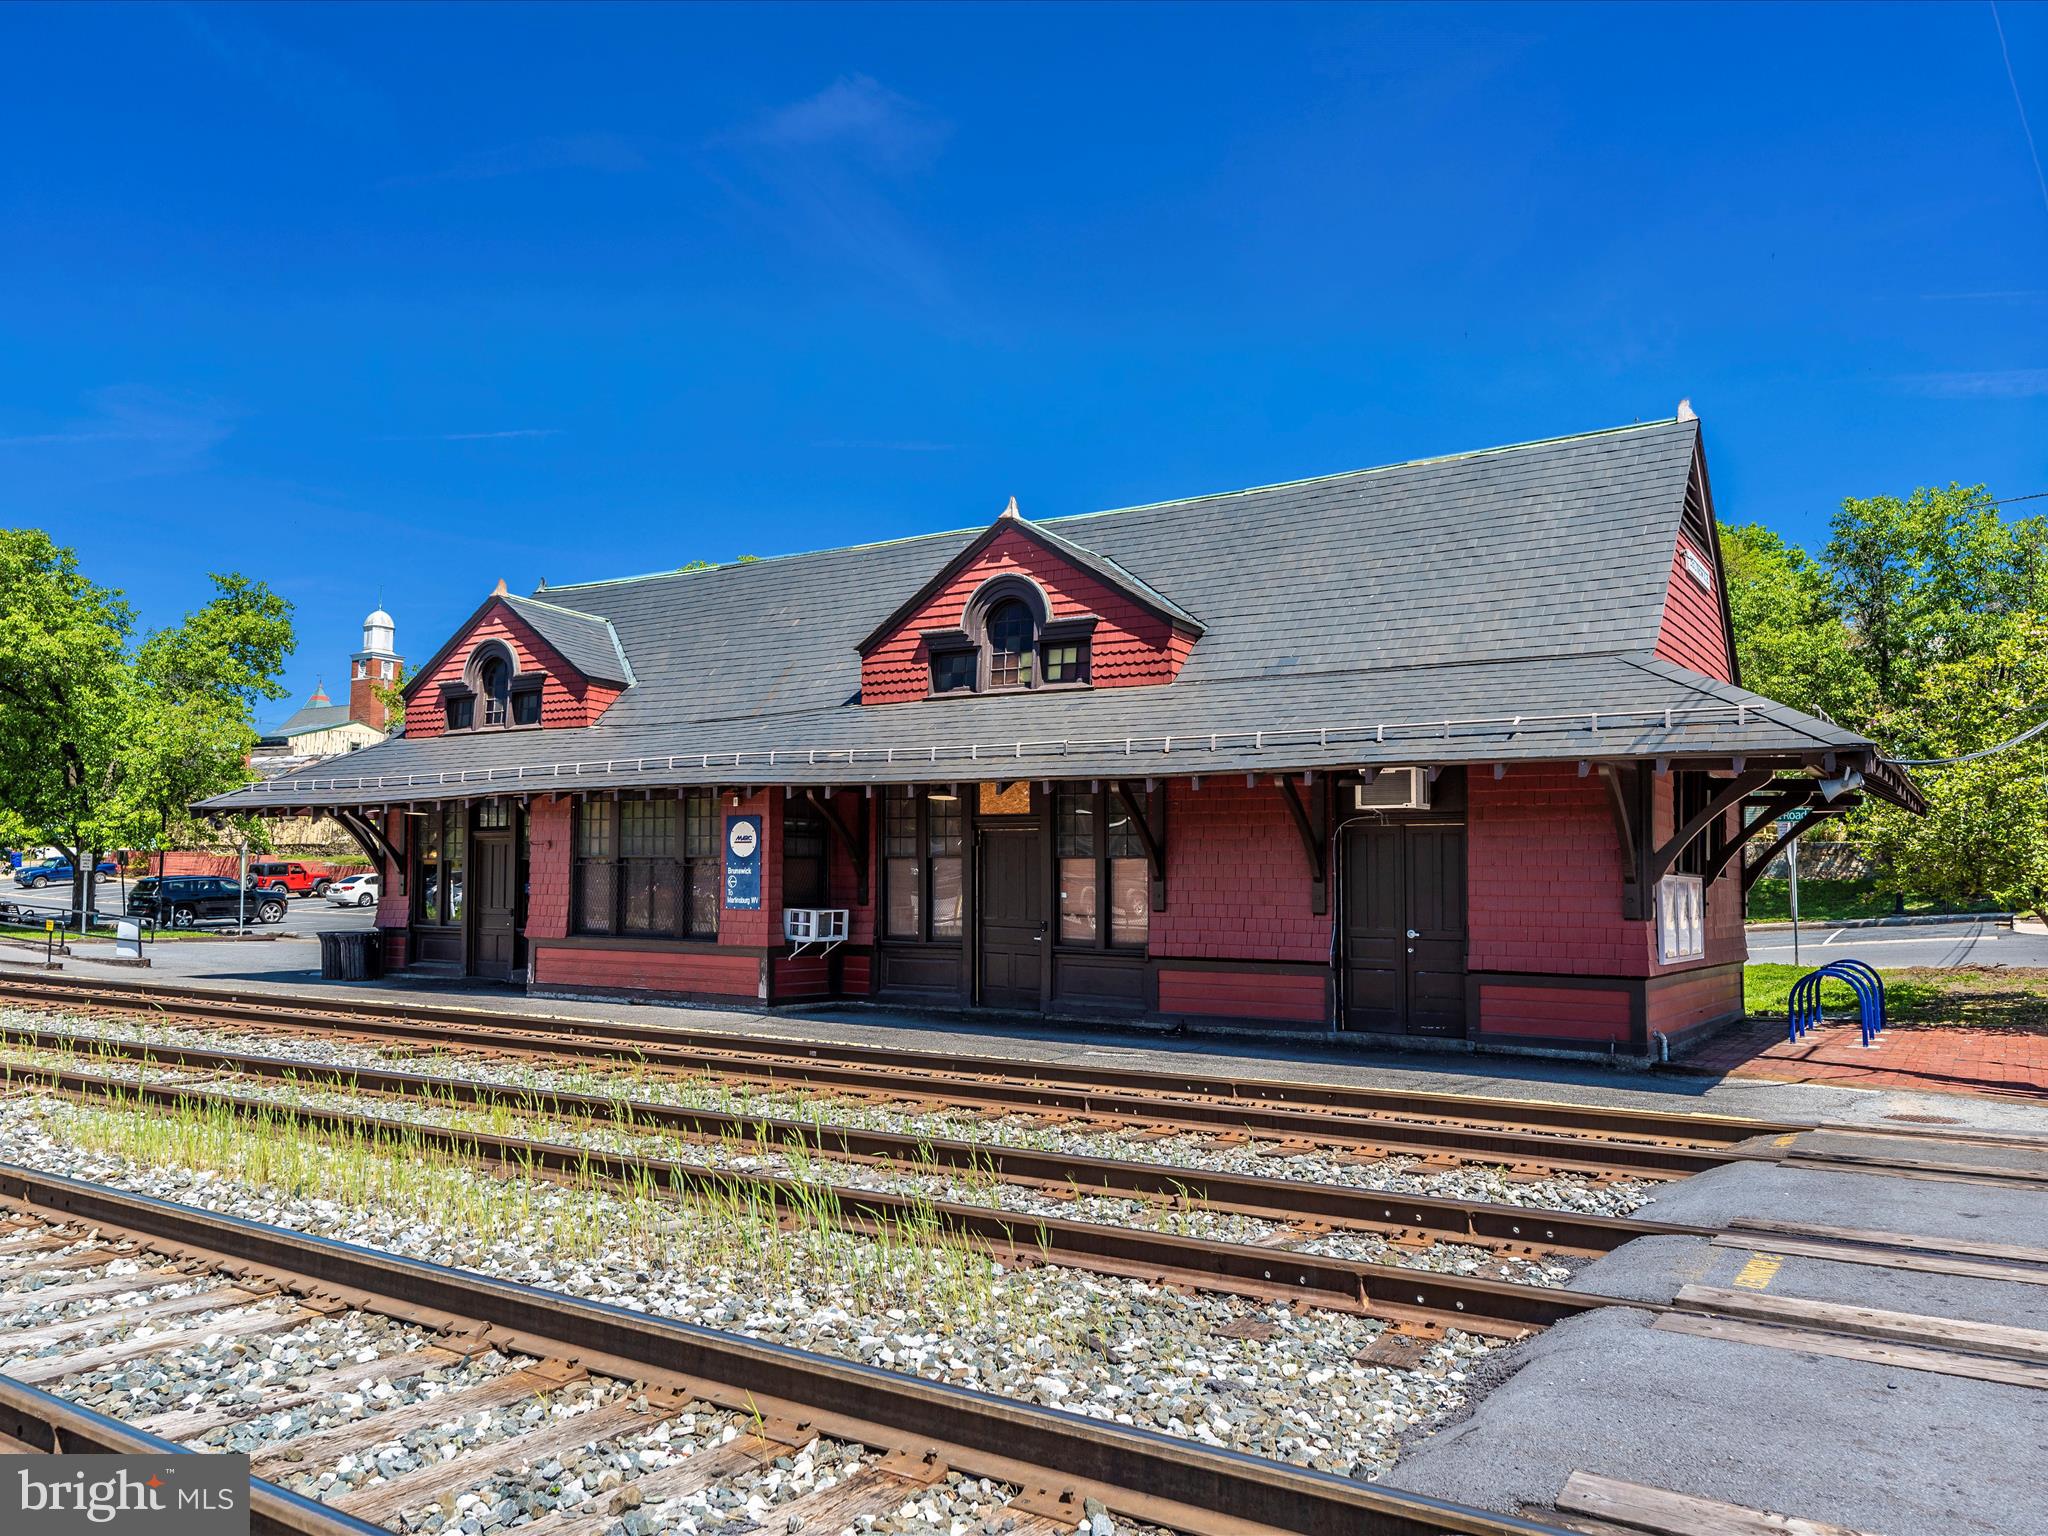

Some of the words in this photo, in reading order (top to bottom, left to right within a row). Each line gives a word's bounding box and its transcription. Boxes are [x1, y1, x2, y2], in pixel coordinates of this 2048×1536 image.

[727, 867, 752, 875] Brunswick
[727, 896, 750, 905] Martinsburg
[751, 896, 759, 904] WV
